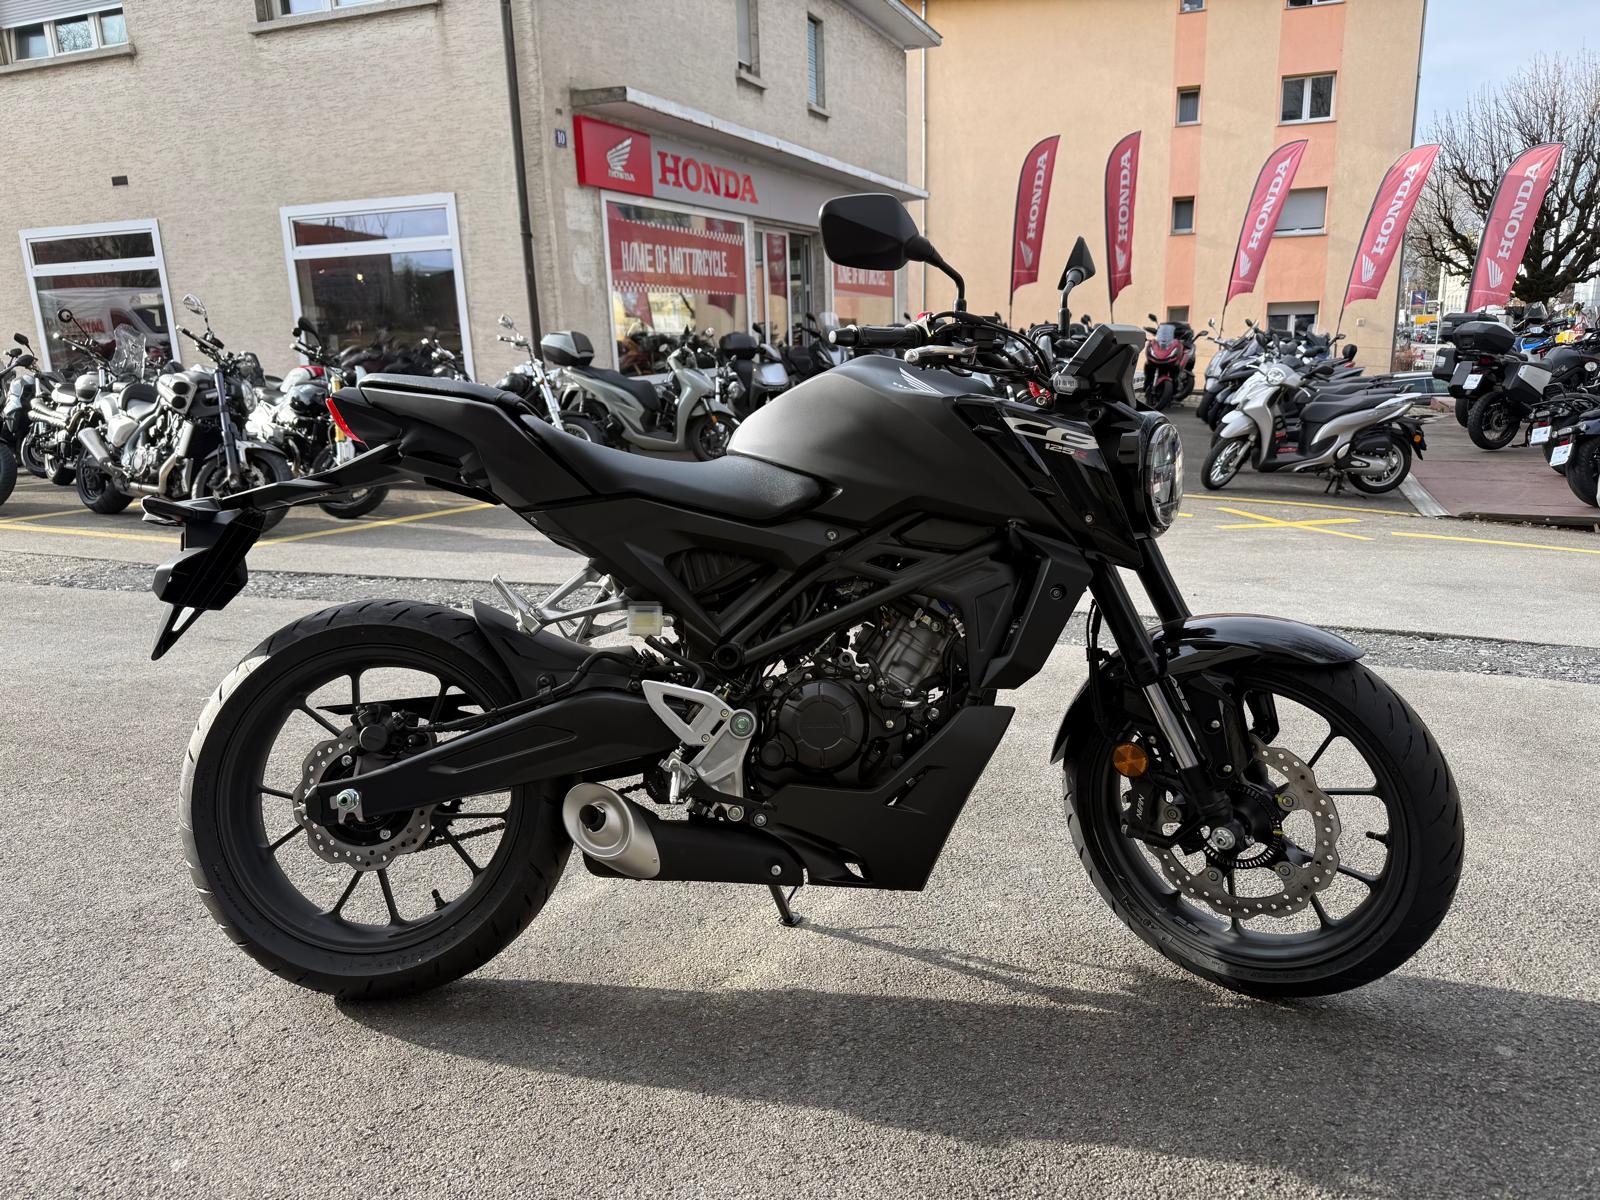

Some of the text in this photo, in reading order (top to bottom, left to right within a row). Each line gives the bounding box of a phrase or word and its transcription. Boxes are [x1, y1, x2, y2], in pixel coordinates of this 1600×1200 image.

[557, 130, 565, 145] 10
[608, 169, 635, 182] HONDA
[656, 150, 759, 204] HONDA
[1027, 151, 1048, 240] HONDA
[1118, 148, 1132, 241] HONDA
[1248, 156, 1291, 250] HONDA
[1371, 161, 1421, 256] HONDA
[1497, 160, 1543, 260] HONDA
[621, 240, 655, 273] HOME
[655, 244, 668, 274] OF
[1003, 417, 1099, 449] CB
[1045, 442, 1089, 459] 125R
